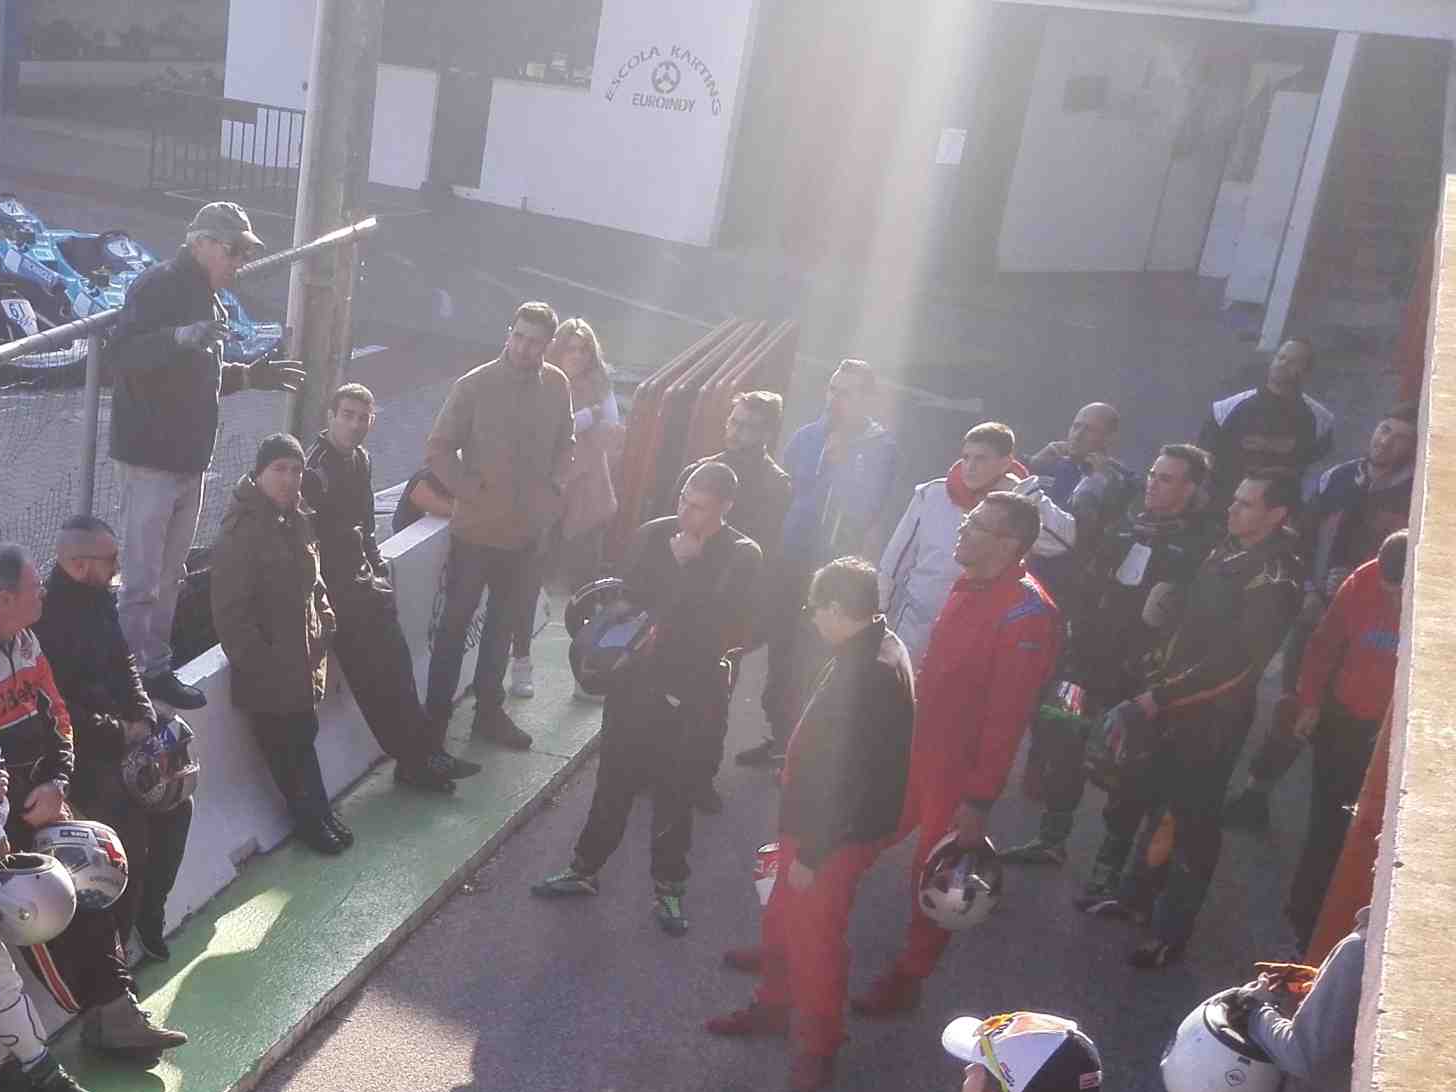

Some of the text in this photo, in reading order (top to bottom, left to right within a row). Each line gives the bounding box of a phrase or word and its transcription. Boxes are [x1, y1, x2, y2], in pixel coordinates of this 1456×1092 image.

[605, 44, 722, 116] ESCOLA KARTING
[632, 92, 696, 112] EUROINDY
